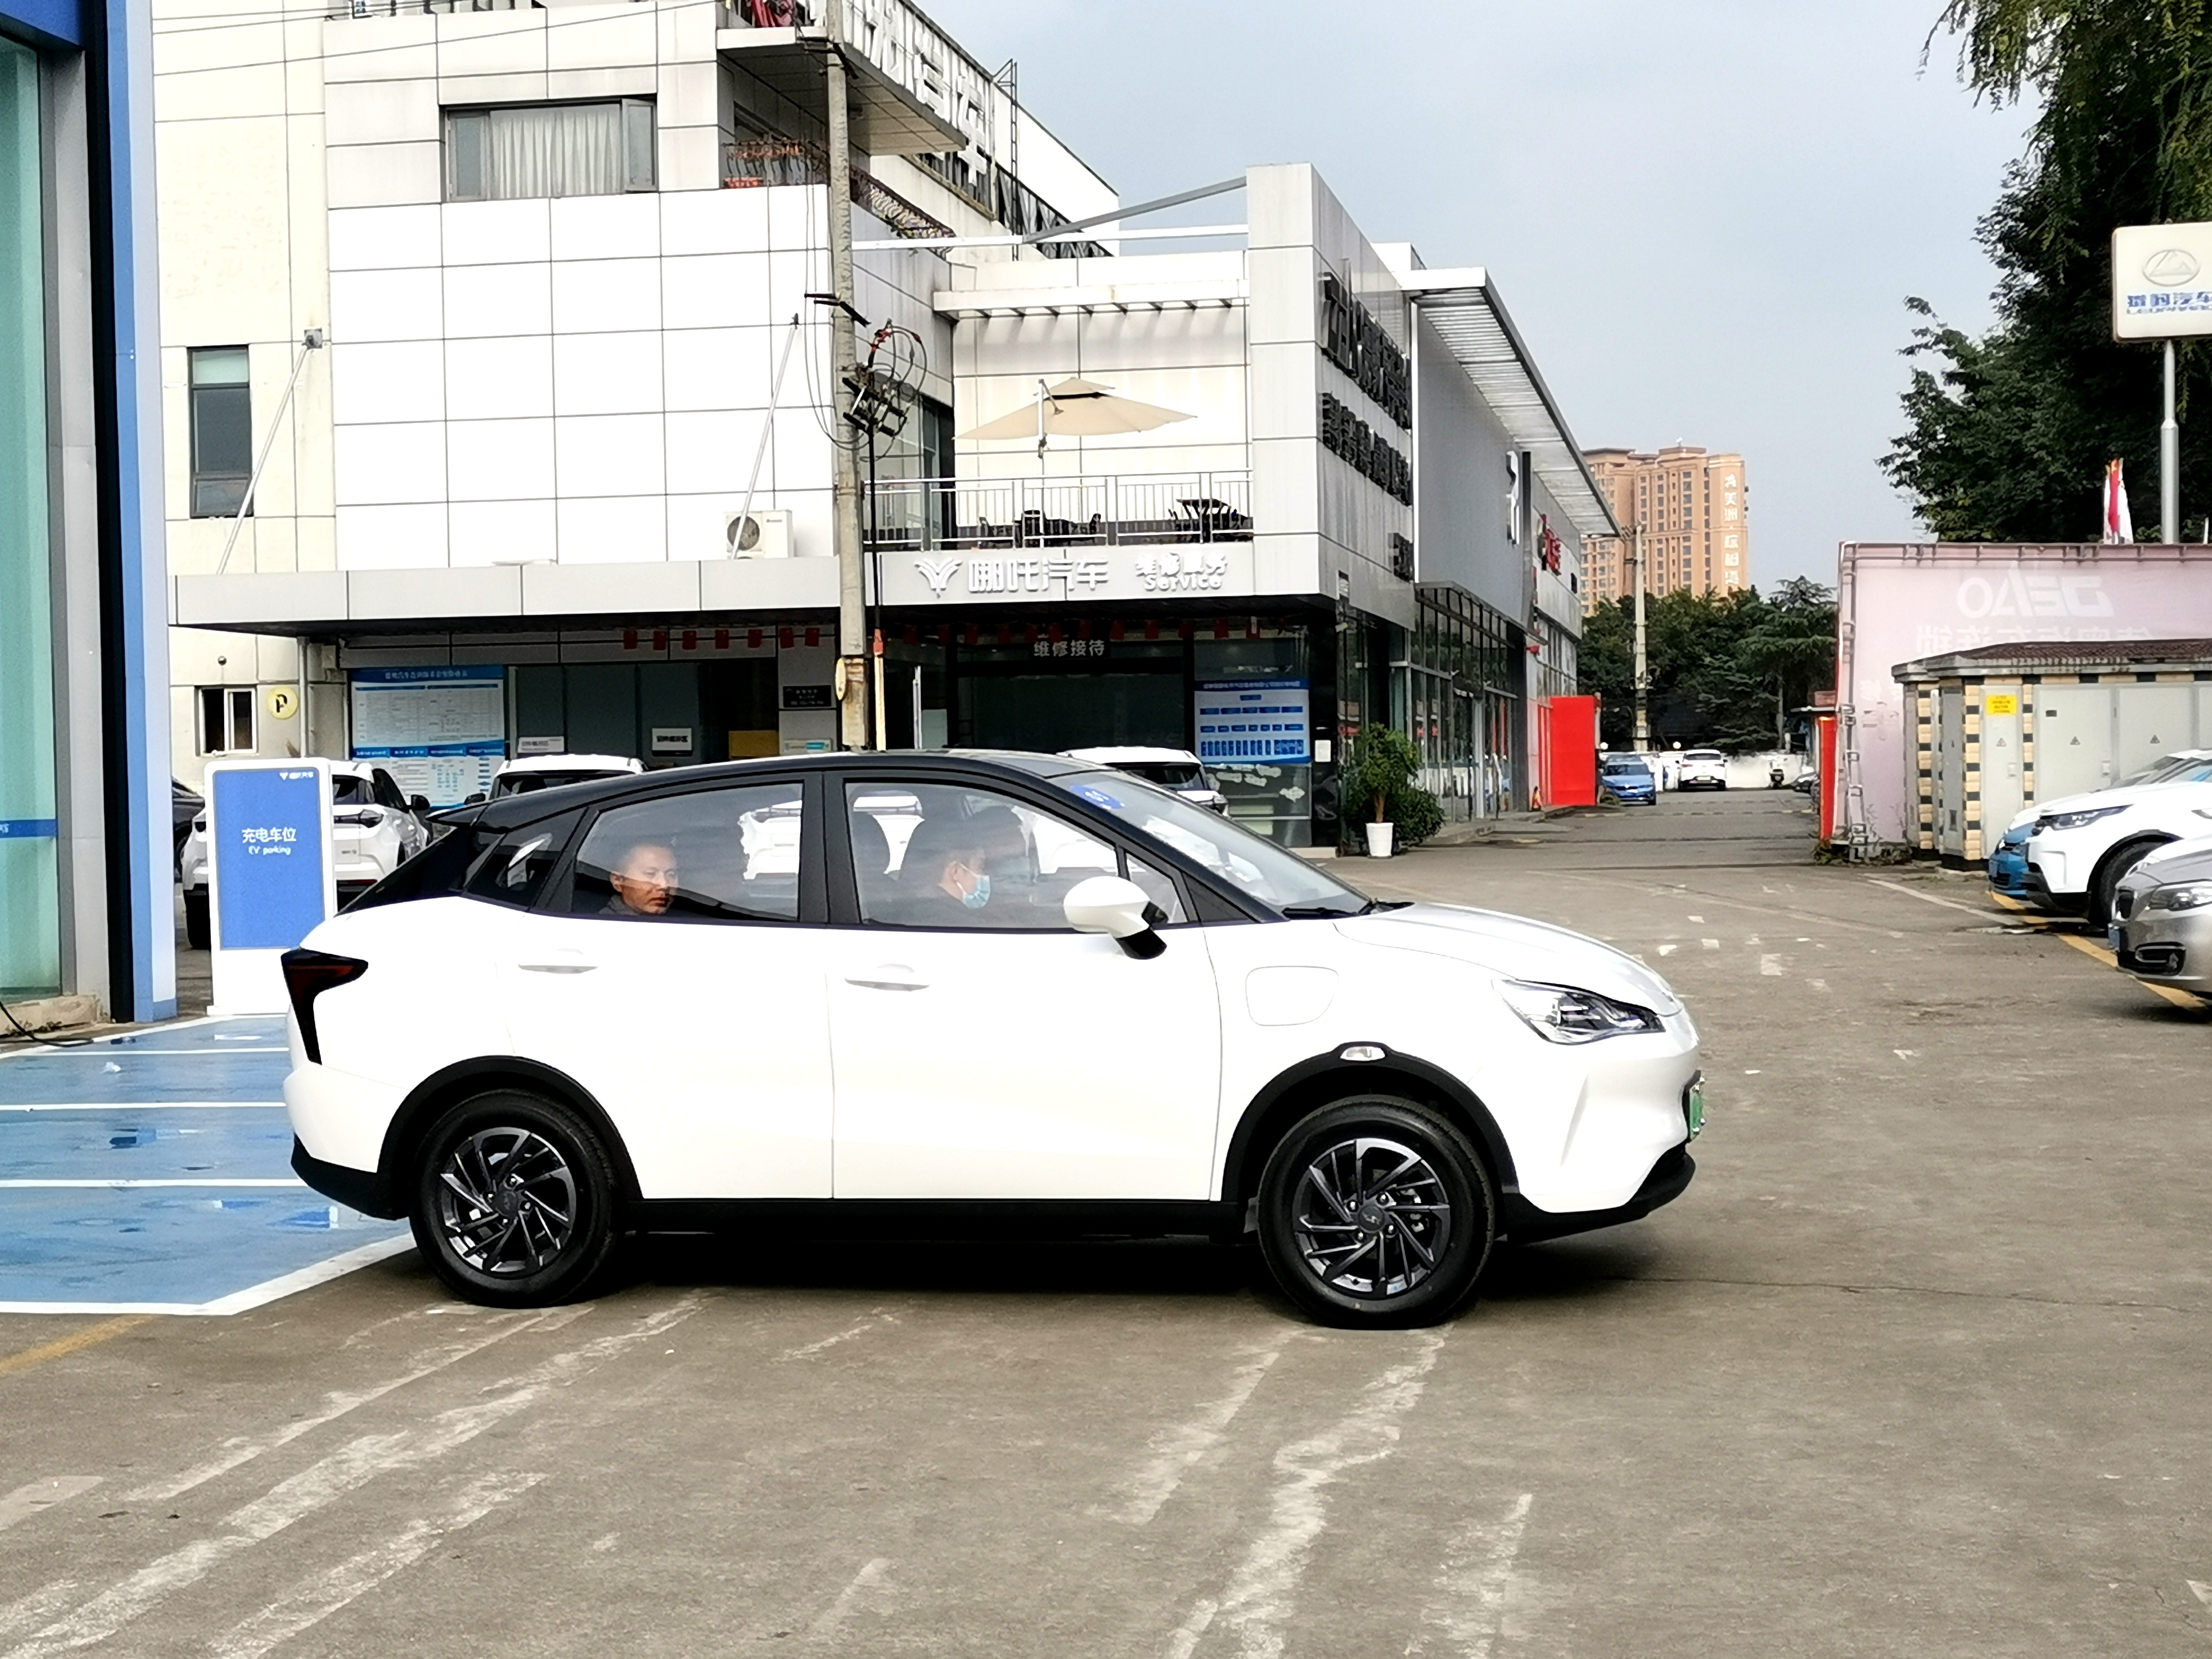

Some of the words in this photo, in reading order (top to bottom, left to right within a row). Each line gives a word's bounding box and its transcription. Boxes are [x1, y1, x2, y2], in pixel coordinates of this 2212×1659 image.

[968, 559, 1108, 593] 哪吒汽车
[1144, 575, 1222, 592] Service
[1034, 639, 1105, 657] 维修接待
[275, 693, 288, 713] P
[241, 827, 296, 843] 充电车位
